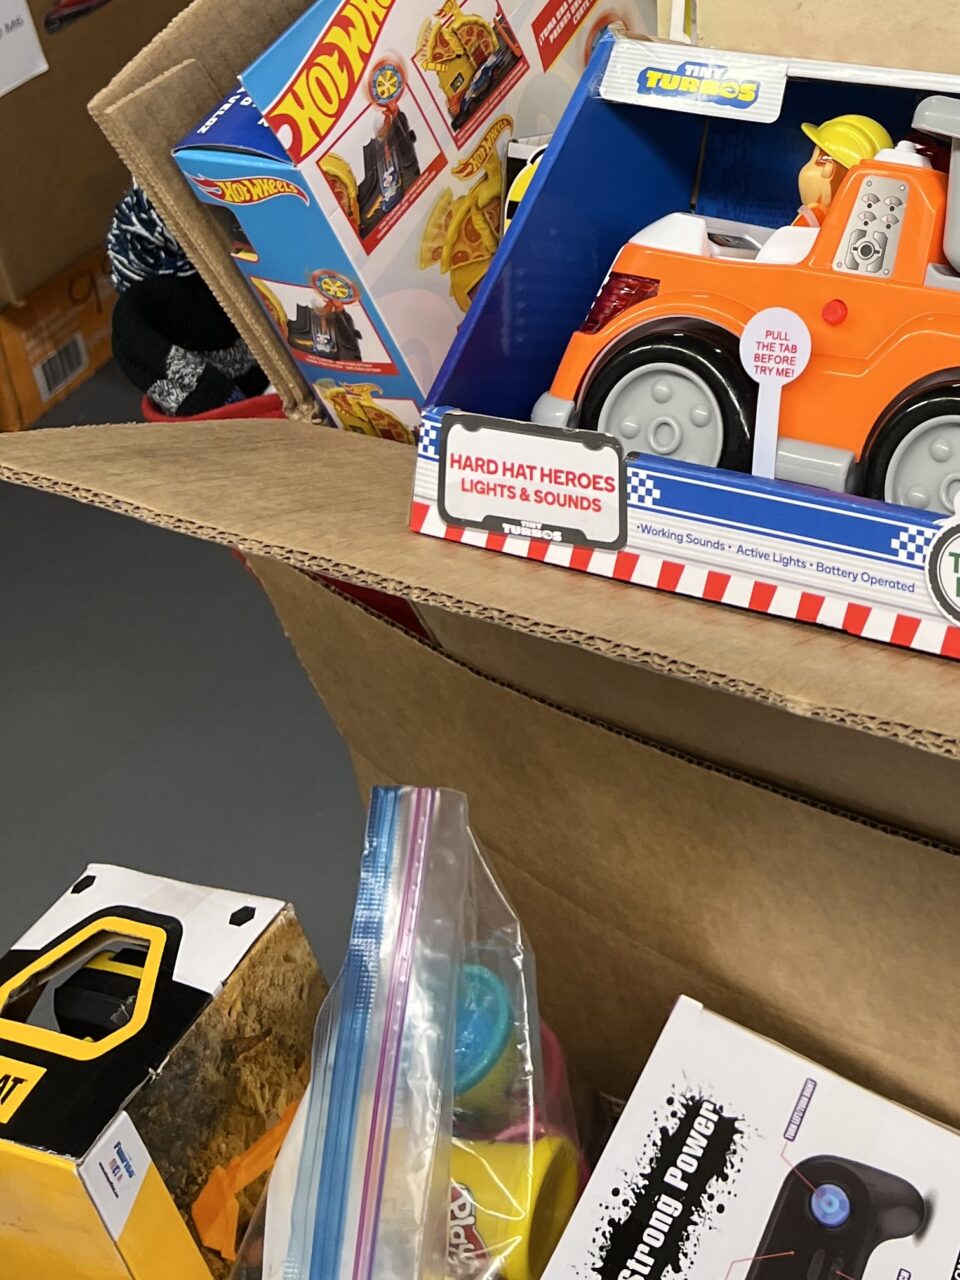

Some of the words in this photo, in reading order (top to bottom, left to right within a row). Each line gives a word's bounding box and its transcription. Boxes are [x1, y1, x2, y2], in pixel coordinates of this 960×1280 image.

[683, 63, 725, 79] TINY
[646, 70, 758, 102] TURBOS
[271, 48, 350, 158] HOT
[217, 181, 251, 202] HOT
[245, 178, 297, 201] WHEELS
[756, 341, 776, 352] THE
[778, 343, 798, 354] TAB
[765, 330, 790, 341] PULL
[754, 353, 797, 366] BEFORE
[754, 365, 774, 376] TRY
[775, 368, 795, 378] ME!
[449, 453, 499, 476] HARD
[502, 461, 537, 481] HAT
[540, 467, 616, 493] HEROES
[461, 477, 516, 500] LIGHTS
[519, 487, 530, 502] &
[534, 490, 602, 513] SOUNDS
[502, 523, 563, 542] TURBOS
[520, 521, 543, 530] TINY
[685, 532, 725, 551] Sounds
[736, 544, 771, 562] Active
[772, 552, 807, 570] Lights
[816, 561, 859, 583] Battery
[860, 571, 916, 594] Operated
[0, 1073, 28, 1106] AT
[662, 1099, 721, 1192] Power
